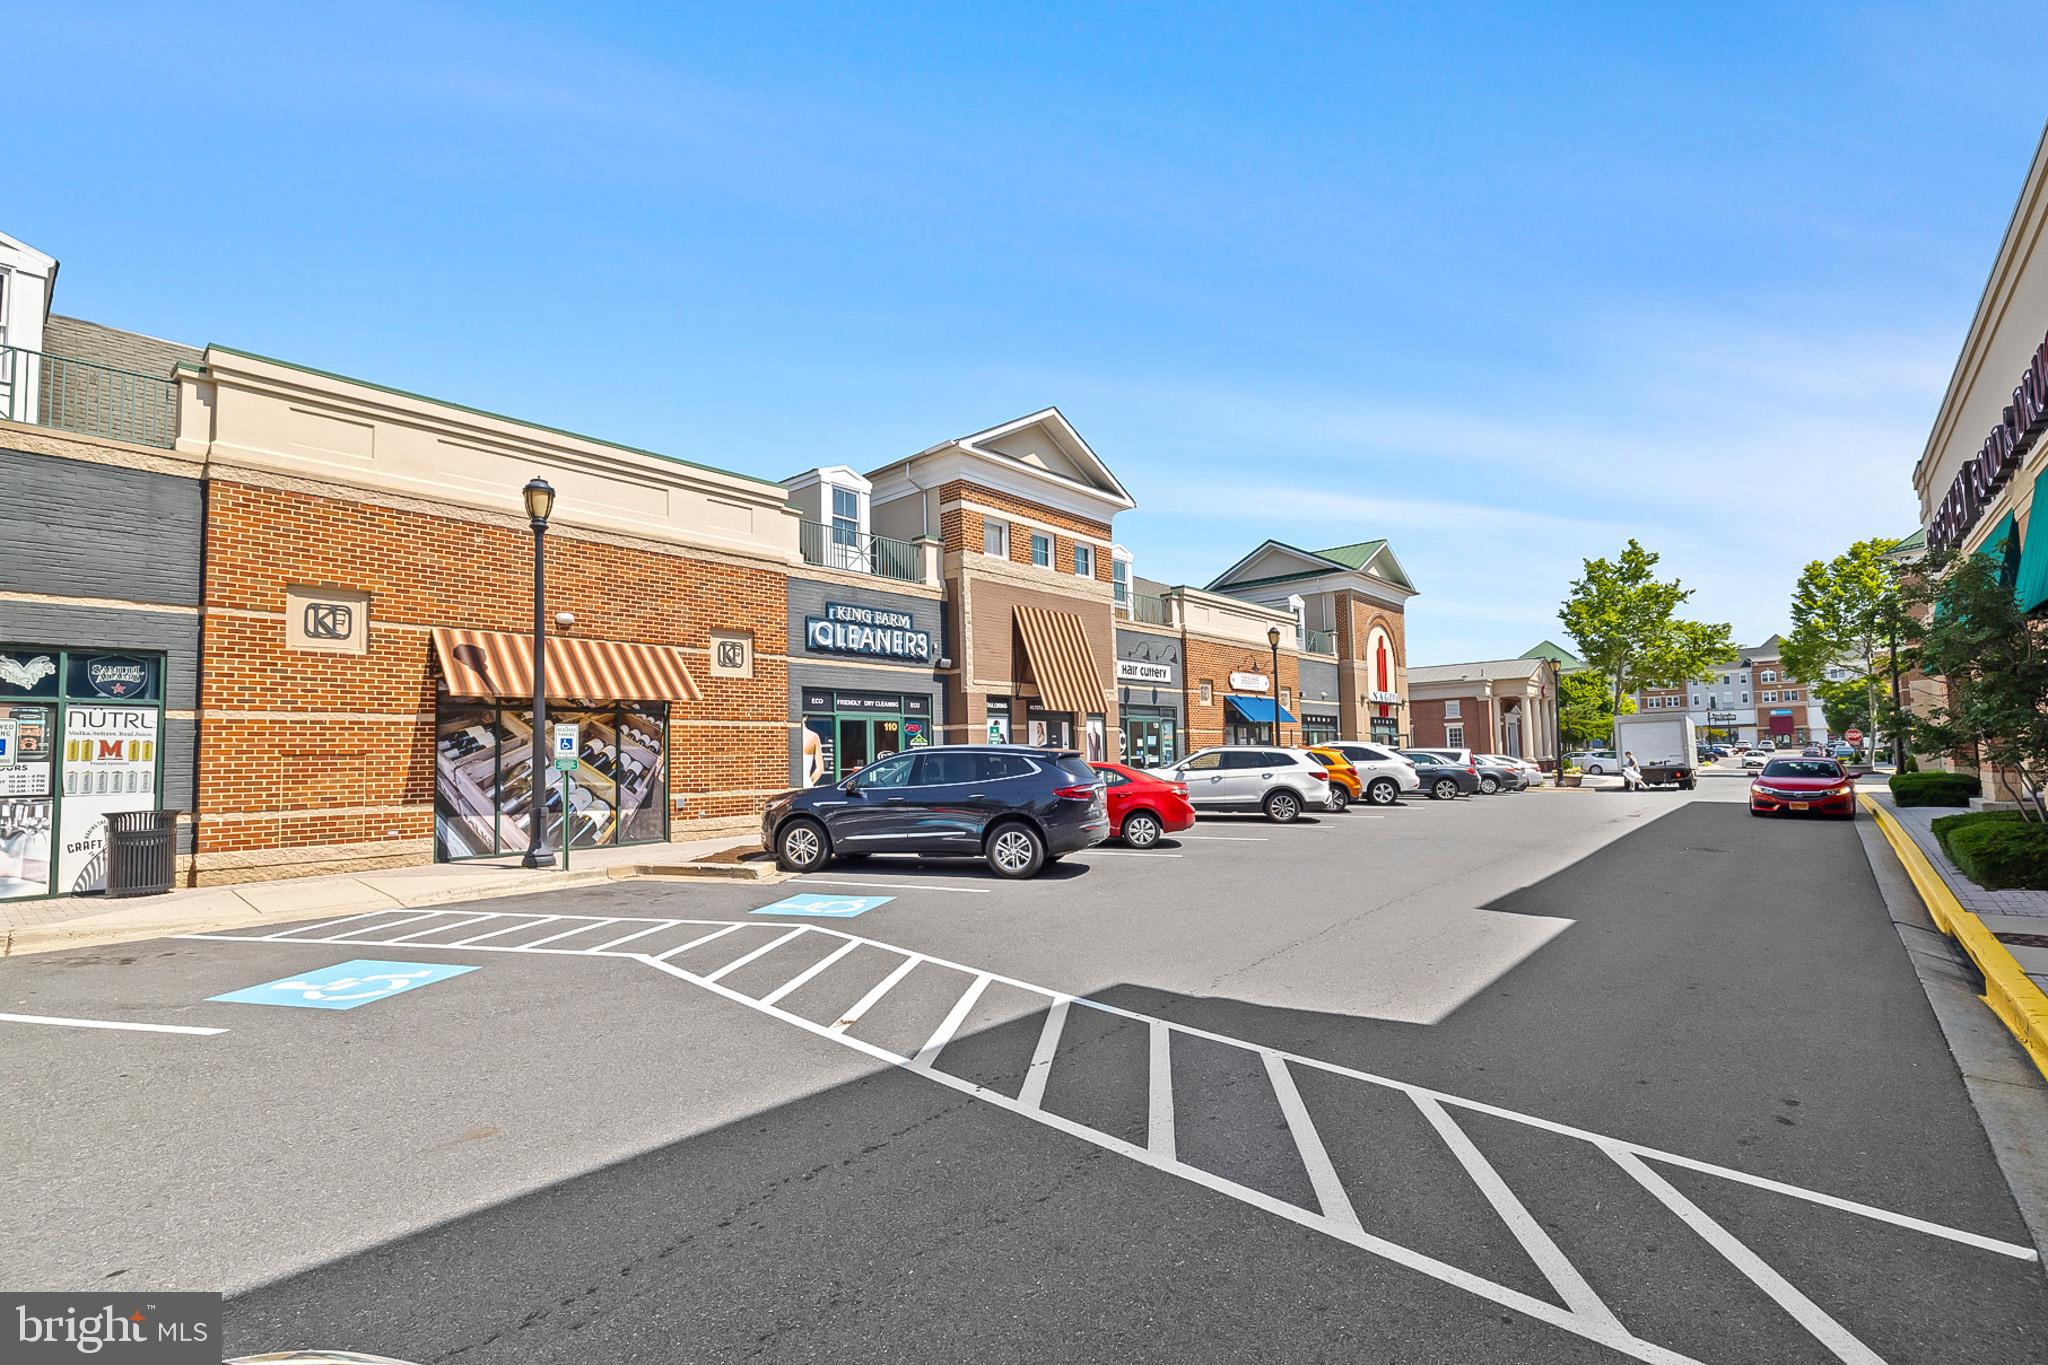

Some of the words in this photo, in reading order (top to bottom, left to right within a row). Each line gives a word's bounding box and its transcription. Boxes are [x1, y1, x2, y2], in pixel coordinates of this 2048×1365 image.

[836, 605, 872, 624] KING
[875, 611, 910, 629] FARM
[814, 621, 928, 657] CLEANERS
[1121, 664, 1138, 675] Hair
[811, 697, 824, 705] ECO
[836, 699, 861, 707] FRIENDLY
[875, 700, 899, 708] CLEANING
[884, 722, 898, 731] 110
[67, 839, 103, 854] CRAFT
